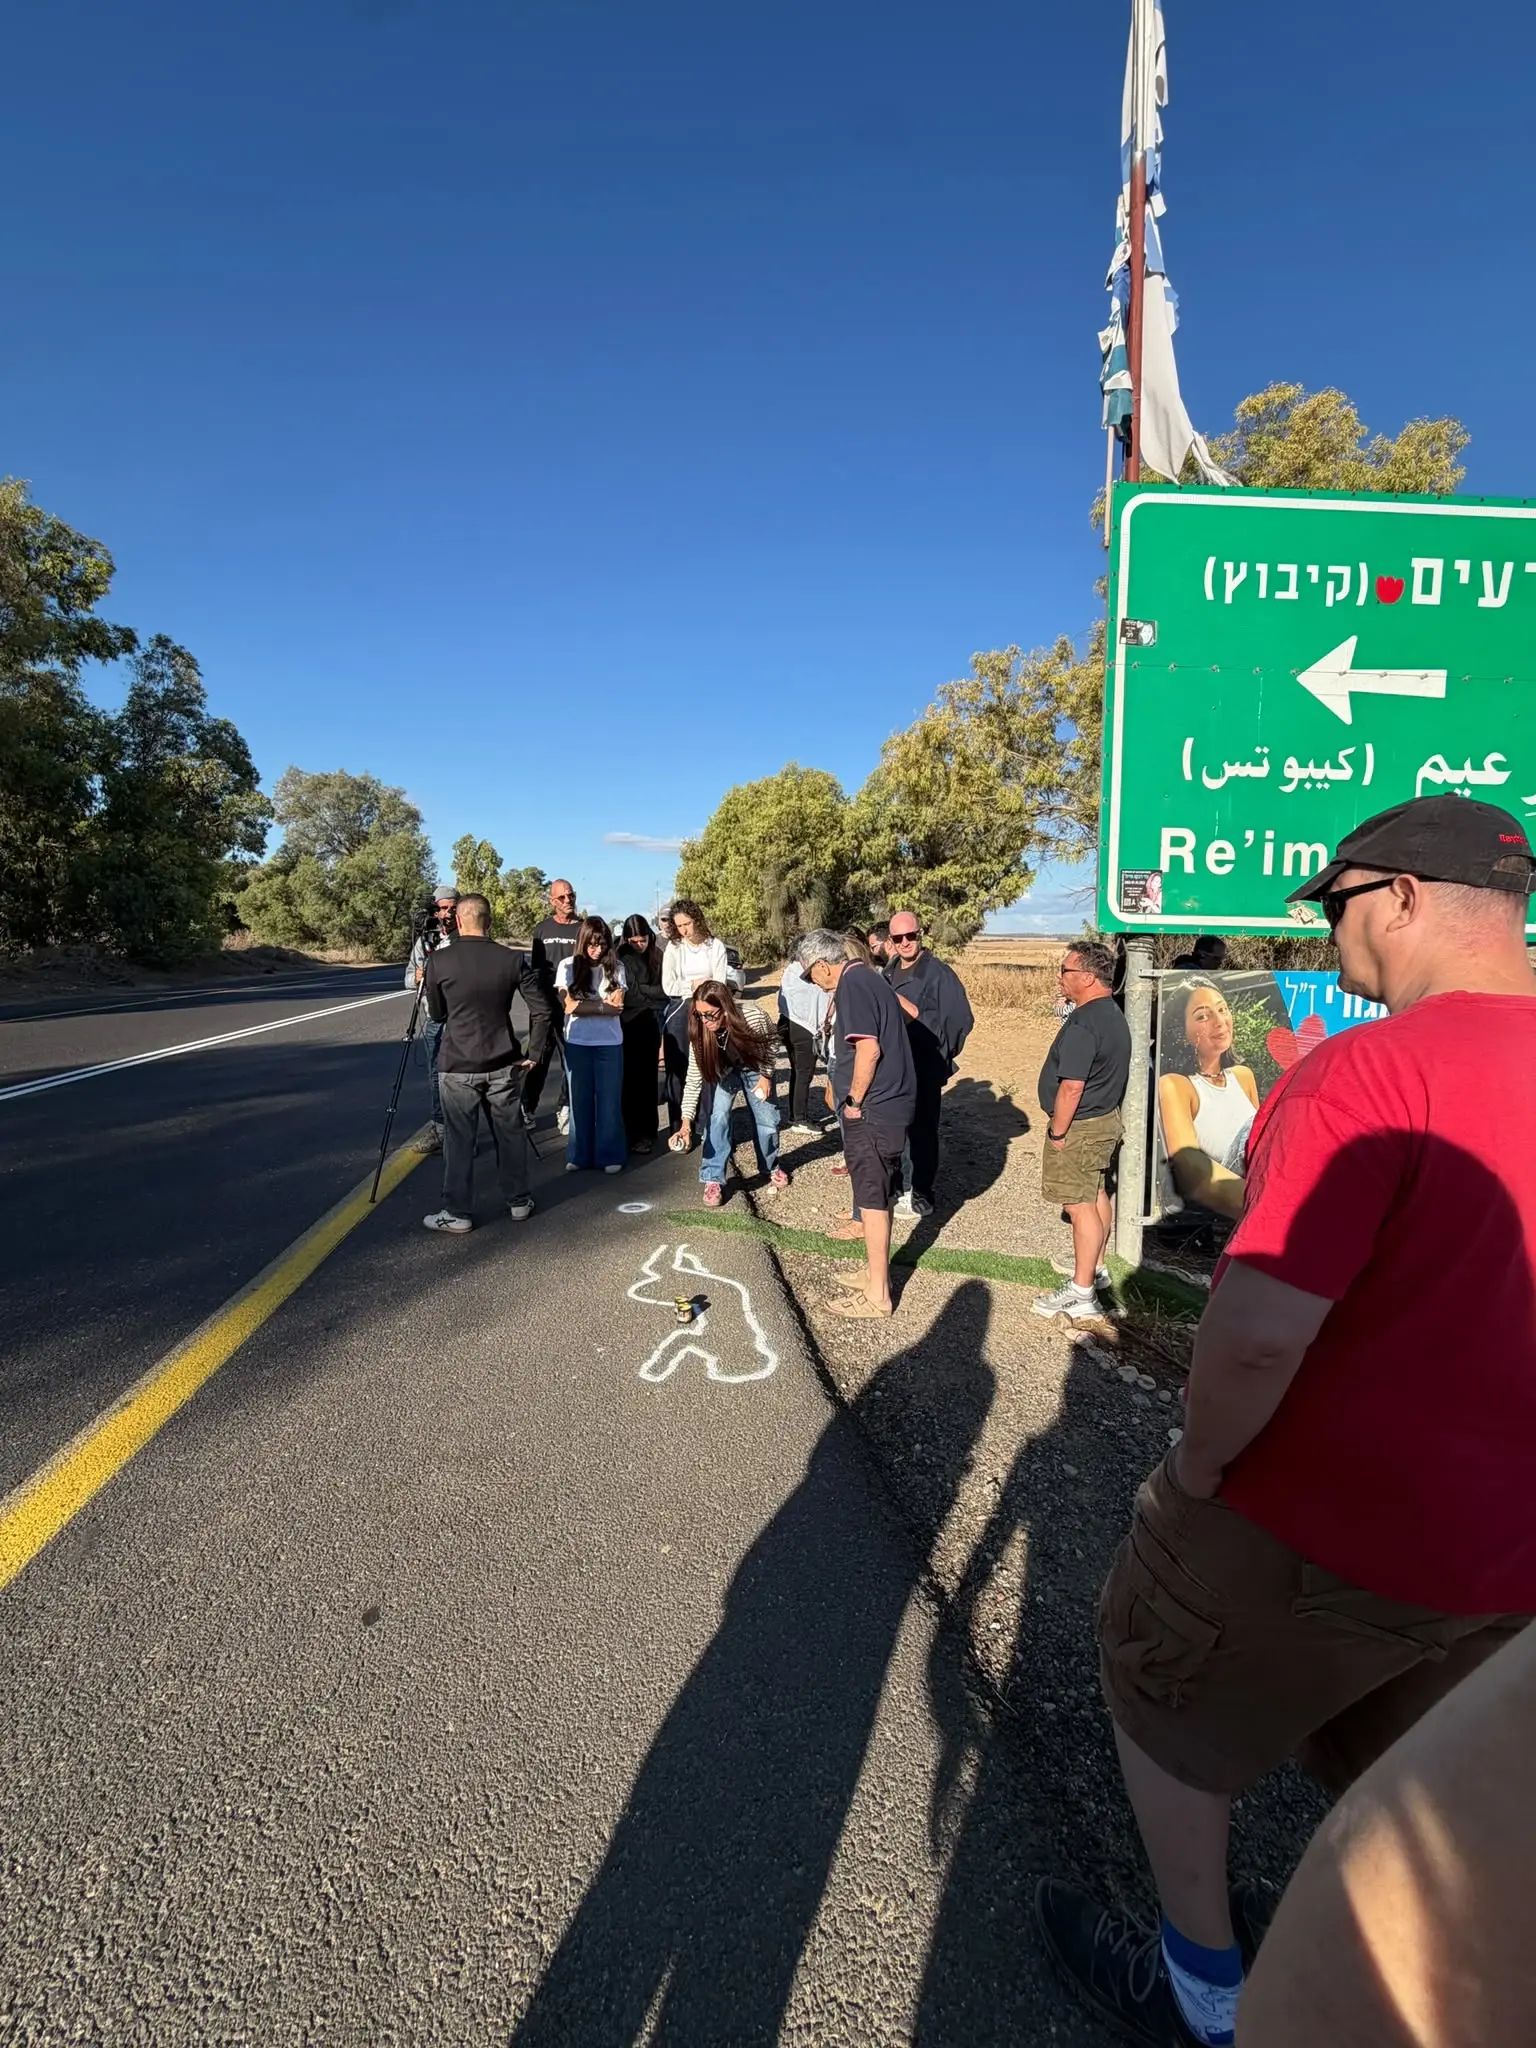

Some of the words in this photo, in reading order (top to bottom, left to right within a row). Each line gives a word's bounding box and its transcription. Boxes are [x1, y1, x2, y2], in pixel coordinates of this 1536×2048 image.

[1203, 556, 1369, 607] (קיבוץ)
[1411, 557, 1536, 608] עים
[1160, 826, 1329, 877] Re'im
